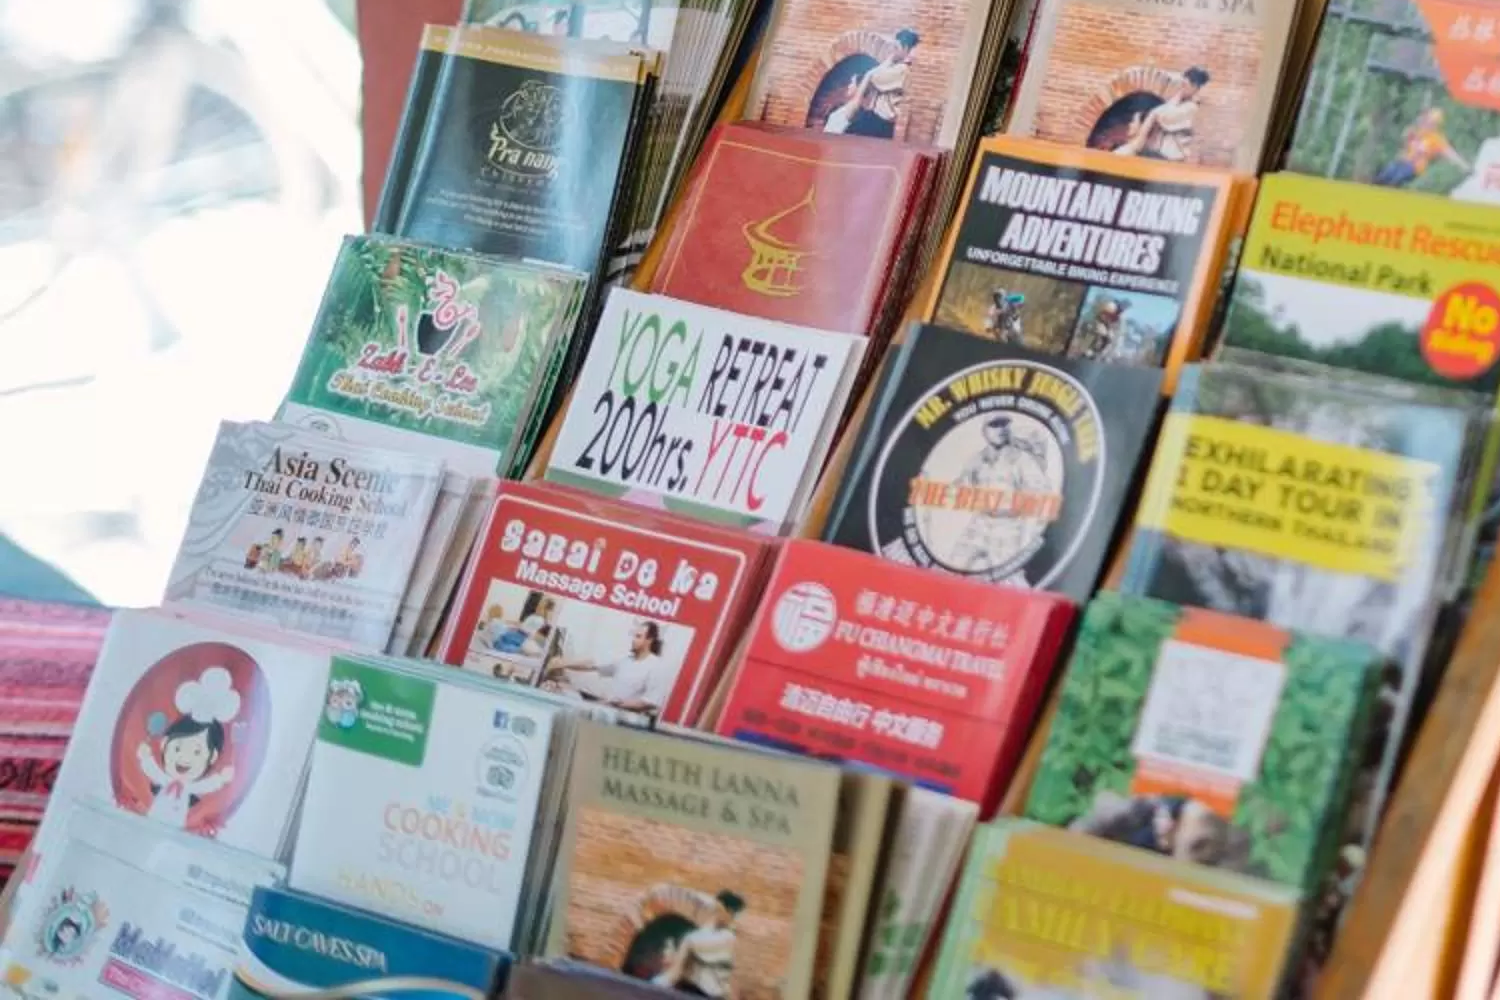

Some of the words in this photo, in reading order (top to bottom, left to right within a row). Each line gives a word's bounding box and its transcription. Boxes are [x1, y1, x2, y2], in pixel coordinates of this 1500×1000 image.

[978, 165, 1123, 224] MOUNTAIN
[1116, 189, 1204, 236] BIKING
[1269, 200, 1406, 244] Elephant
[966, 245, 1068, 277] UNFORGETTABLE
[1067, 265, 1109, 284] BIKING
[998, 211, 1166, 275] ADVENTURES
[1260, 244, 1372, 283] National
[1375, 264, 1432, 294] Park
[1442, 292, 1500, 335] No
[607, 308, 705, 408] YOGA
[698, 332, 828, 433] RETREAT
[914, 394, 952, 430] MR.
[949, 366, 1028, 401] WHISKY
[243, 469, 283, 496] Thai
[285, 479, 354, 513] Cooking
[263, 445, 319, 481] Asia
[693, 419, 790, 512] YTTC
[1186, 434, 1414, 501] EXHILARATING
[1173, 496, 1284, 532] NORTHERN
[1201, 467, 1264, 500] DAY
[1278, 484, 1364, 522] TOUR
[1372, 504, 1402, 530] IN
[515, 558, 607, 601] Massage
[609, 583, 682, 617] School
[833, 619, 858, 643] FU
[602, 745, 702, 790] HEALTH
[711, 761, 800, 807] LANNA
[383, 802, 513, 861] COOKING
[601, 777, 710, 821] MASSAGE
[720, 799, 739, 823] &
[748, 805, 793, 836] SPA
[378, 831, 502, 893] SCHOOL
[251, 913, 294, 944] SALT
